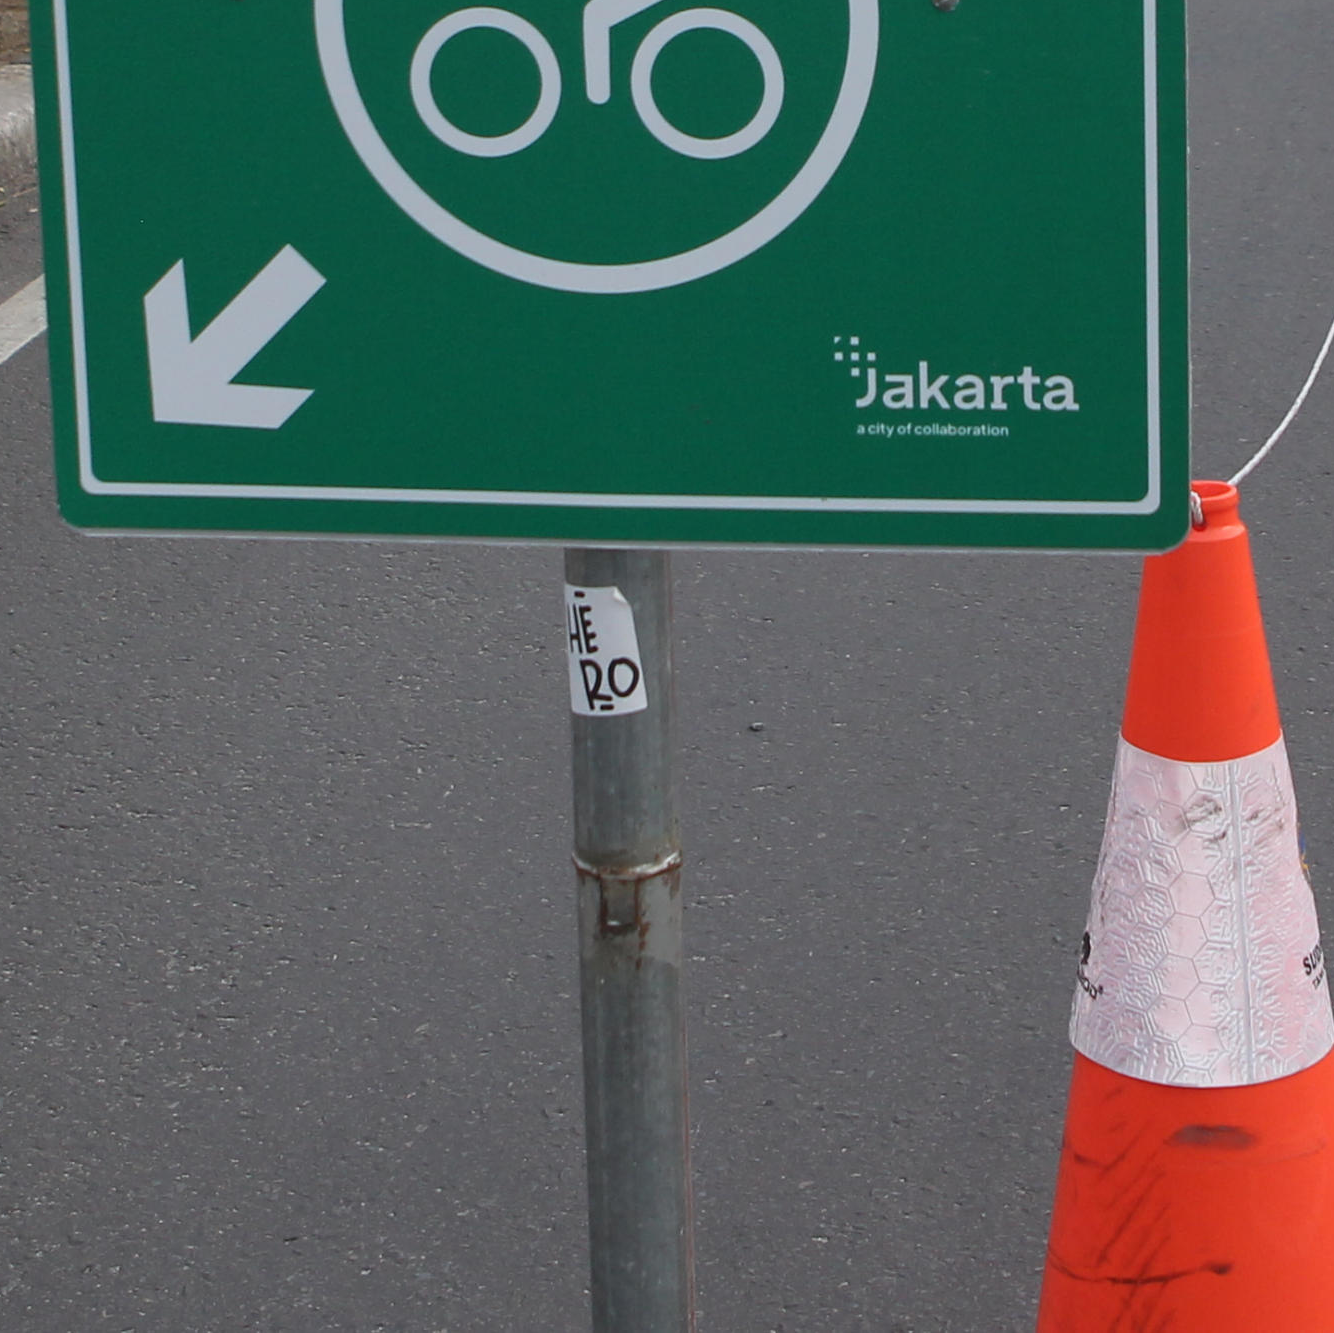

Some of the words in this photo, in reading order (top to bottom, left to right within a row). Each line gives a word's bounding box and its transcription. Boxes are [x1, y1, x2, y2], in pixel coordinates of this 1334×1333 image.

[856, 424, 866, 435] a
[867, 422, 895, 438] city
[897, 422, 913, 436] of
[914, 422, 1010, 437] collaboration
